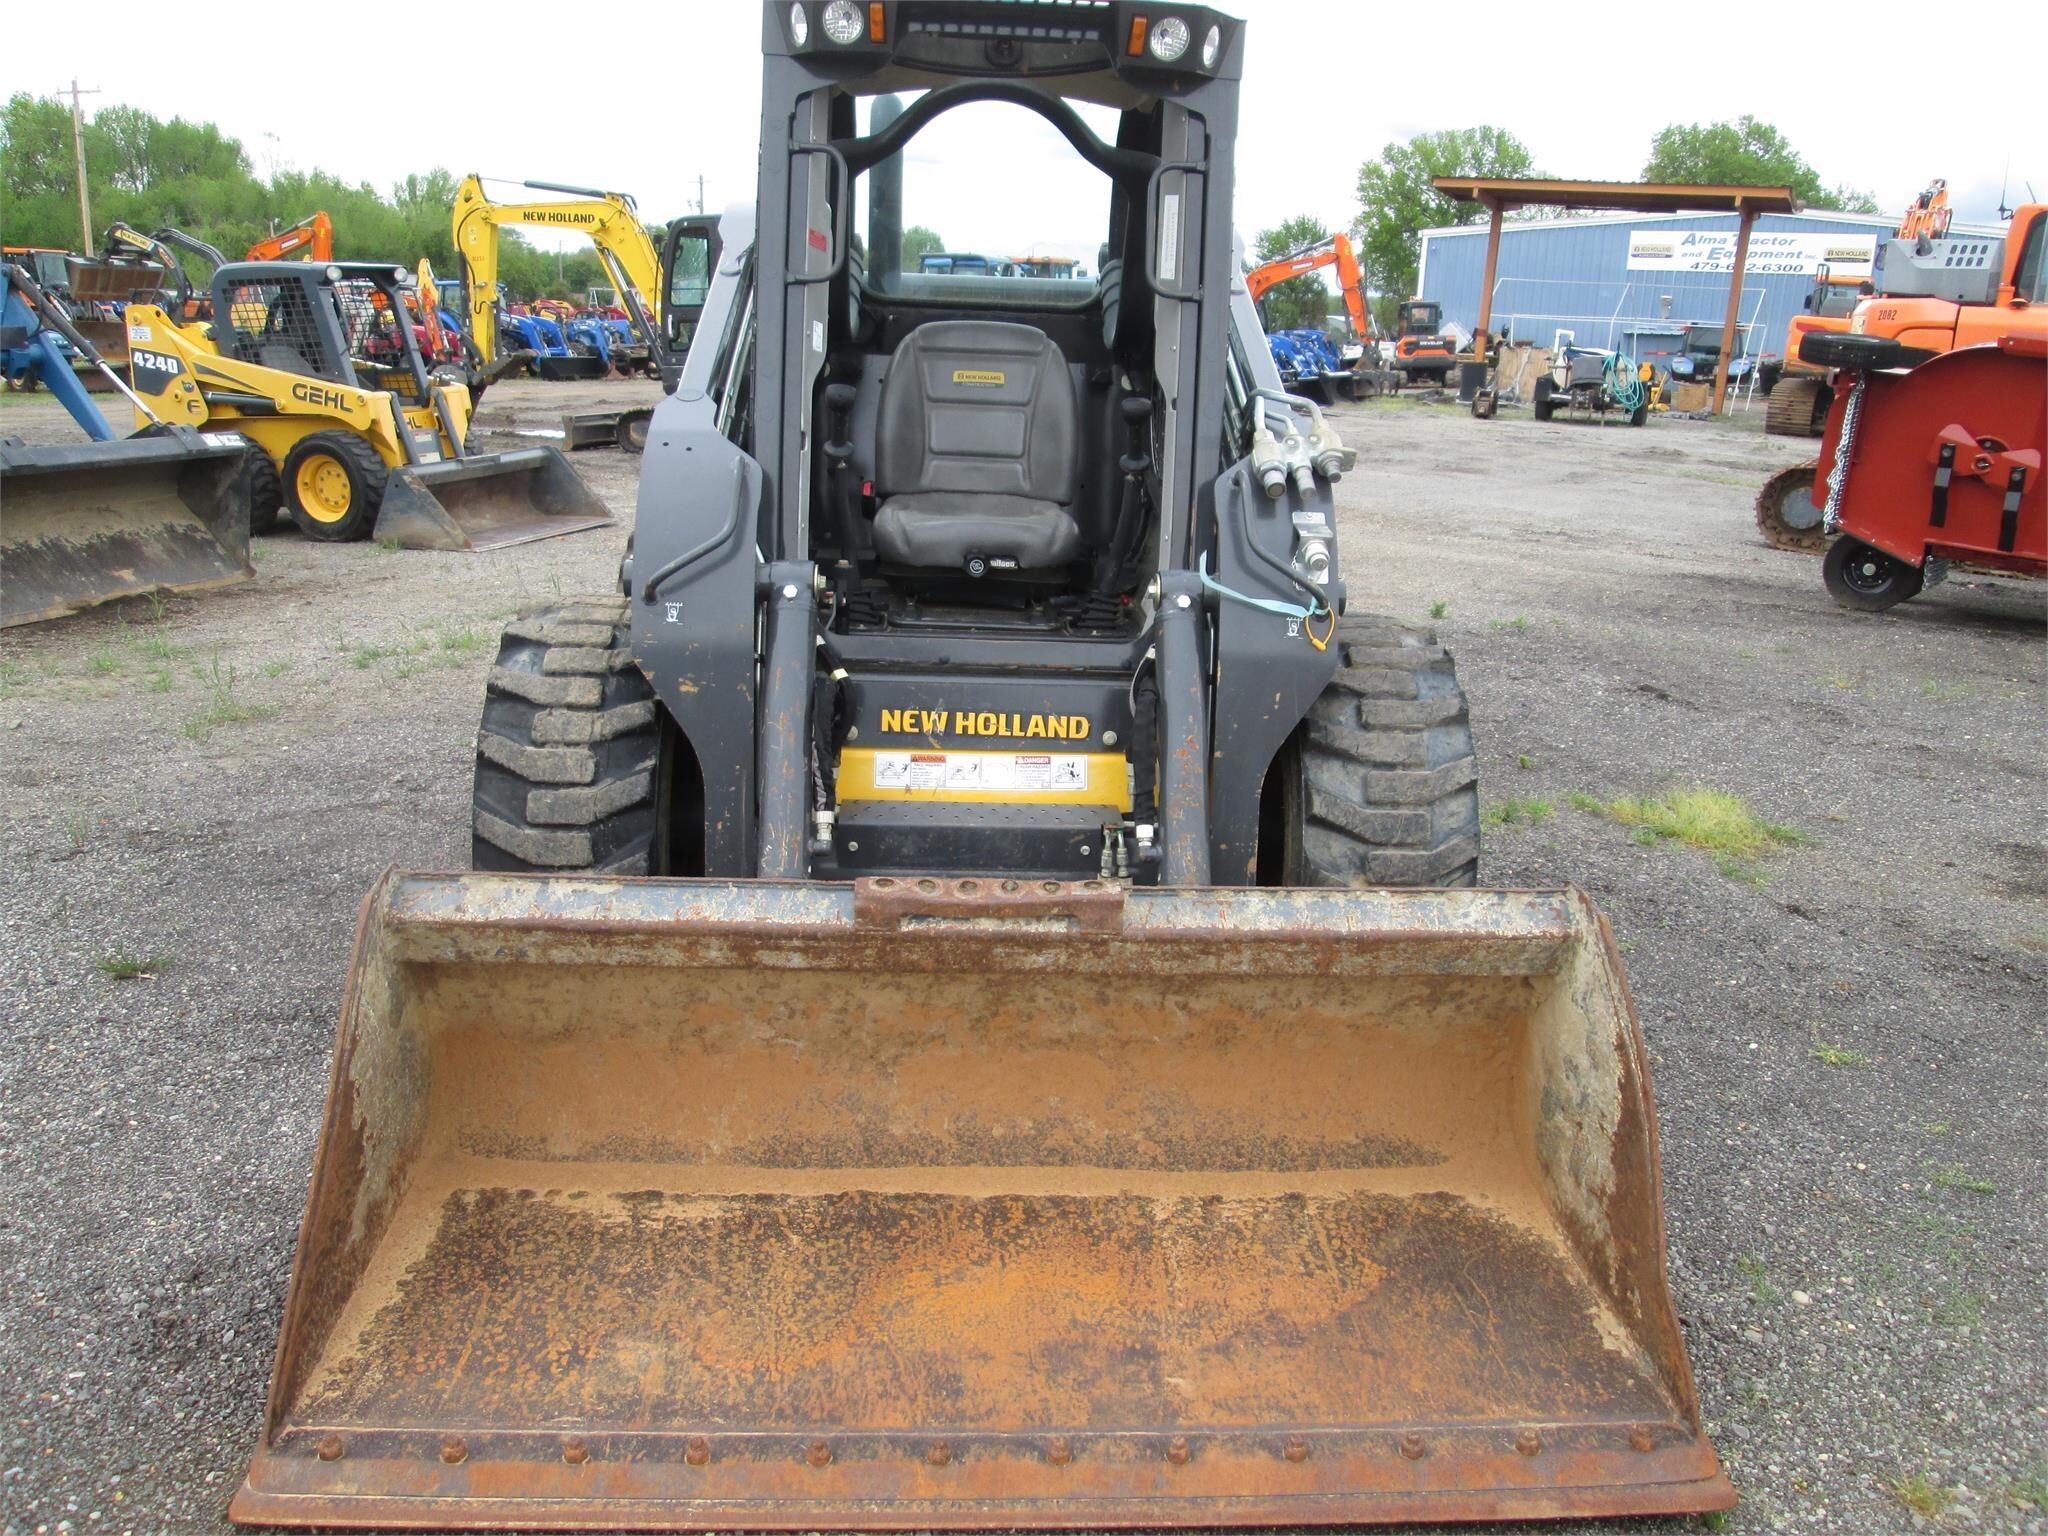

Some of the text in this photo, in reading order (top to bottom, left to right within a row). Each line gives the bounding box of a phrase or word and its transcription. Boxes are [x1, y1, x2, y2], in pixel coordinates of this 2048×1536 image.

[523, 211, 595, 223] NEW HOLLAND
[1681, 233, 1797, 246] Alma Tactor
[1707, 247, 1803, 260] Eqpment
[1690, 262, 1804, 273] 479-62-6300
[1878, 309, 1897, 320] 2082
[133, 351, 179, 374] 4240
[292, 383, 353, 413] GEHL
[881, 709, 1090, 739] NEW HOLLAND
